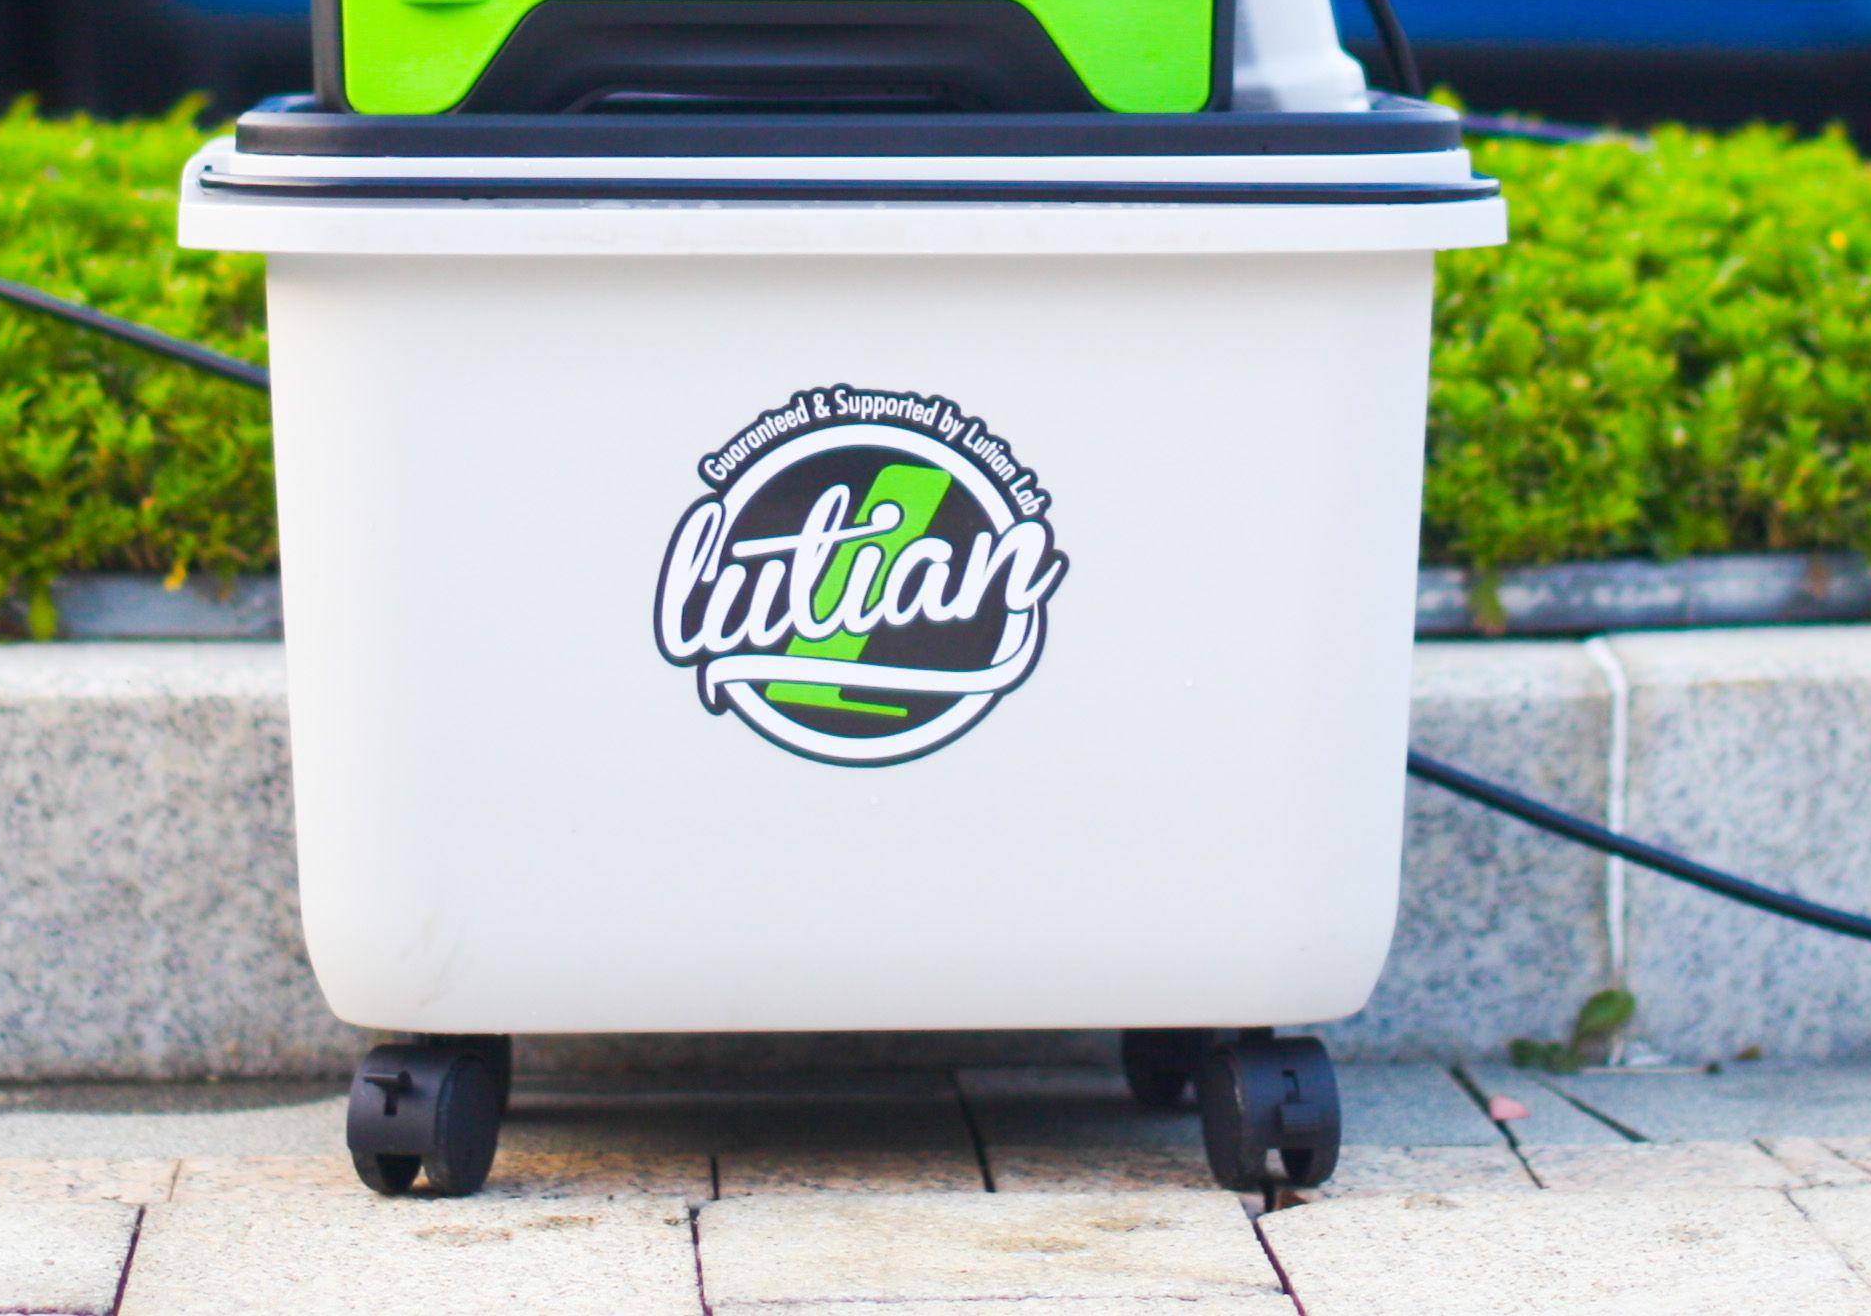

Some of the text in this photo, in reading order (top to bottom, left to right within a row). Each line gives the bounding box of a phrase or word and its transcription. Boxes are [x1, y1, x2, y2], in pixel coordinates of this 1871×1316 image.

[704, 389, 1046, 516] Guaranteed & Supported by Lutian Lab
[660, 483, 1063, 658] lutian
